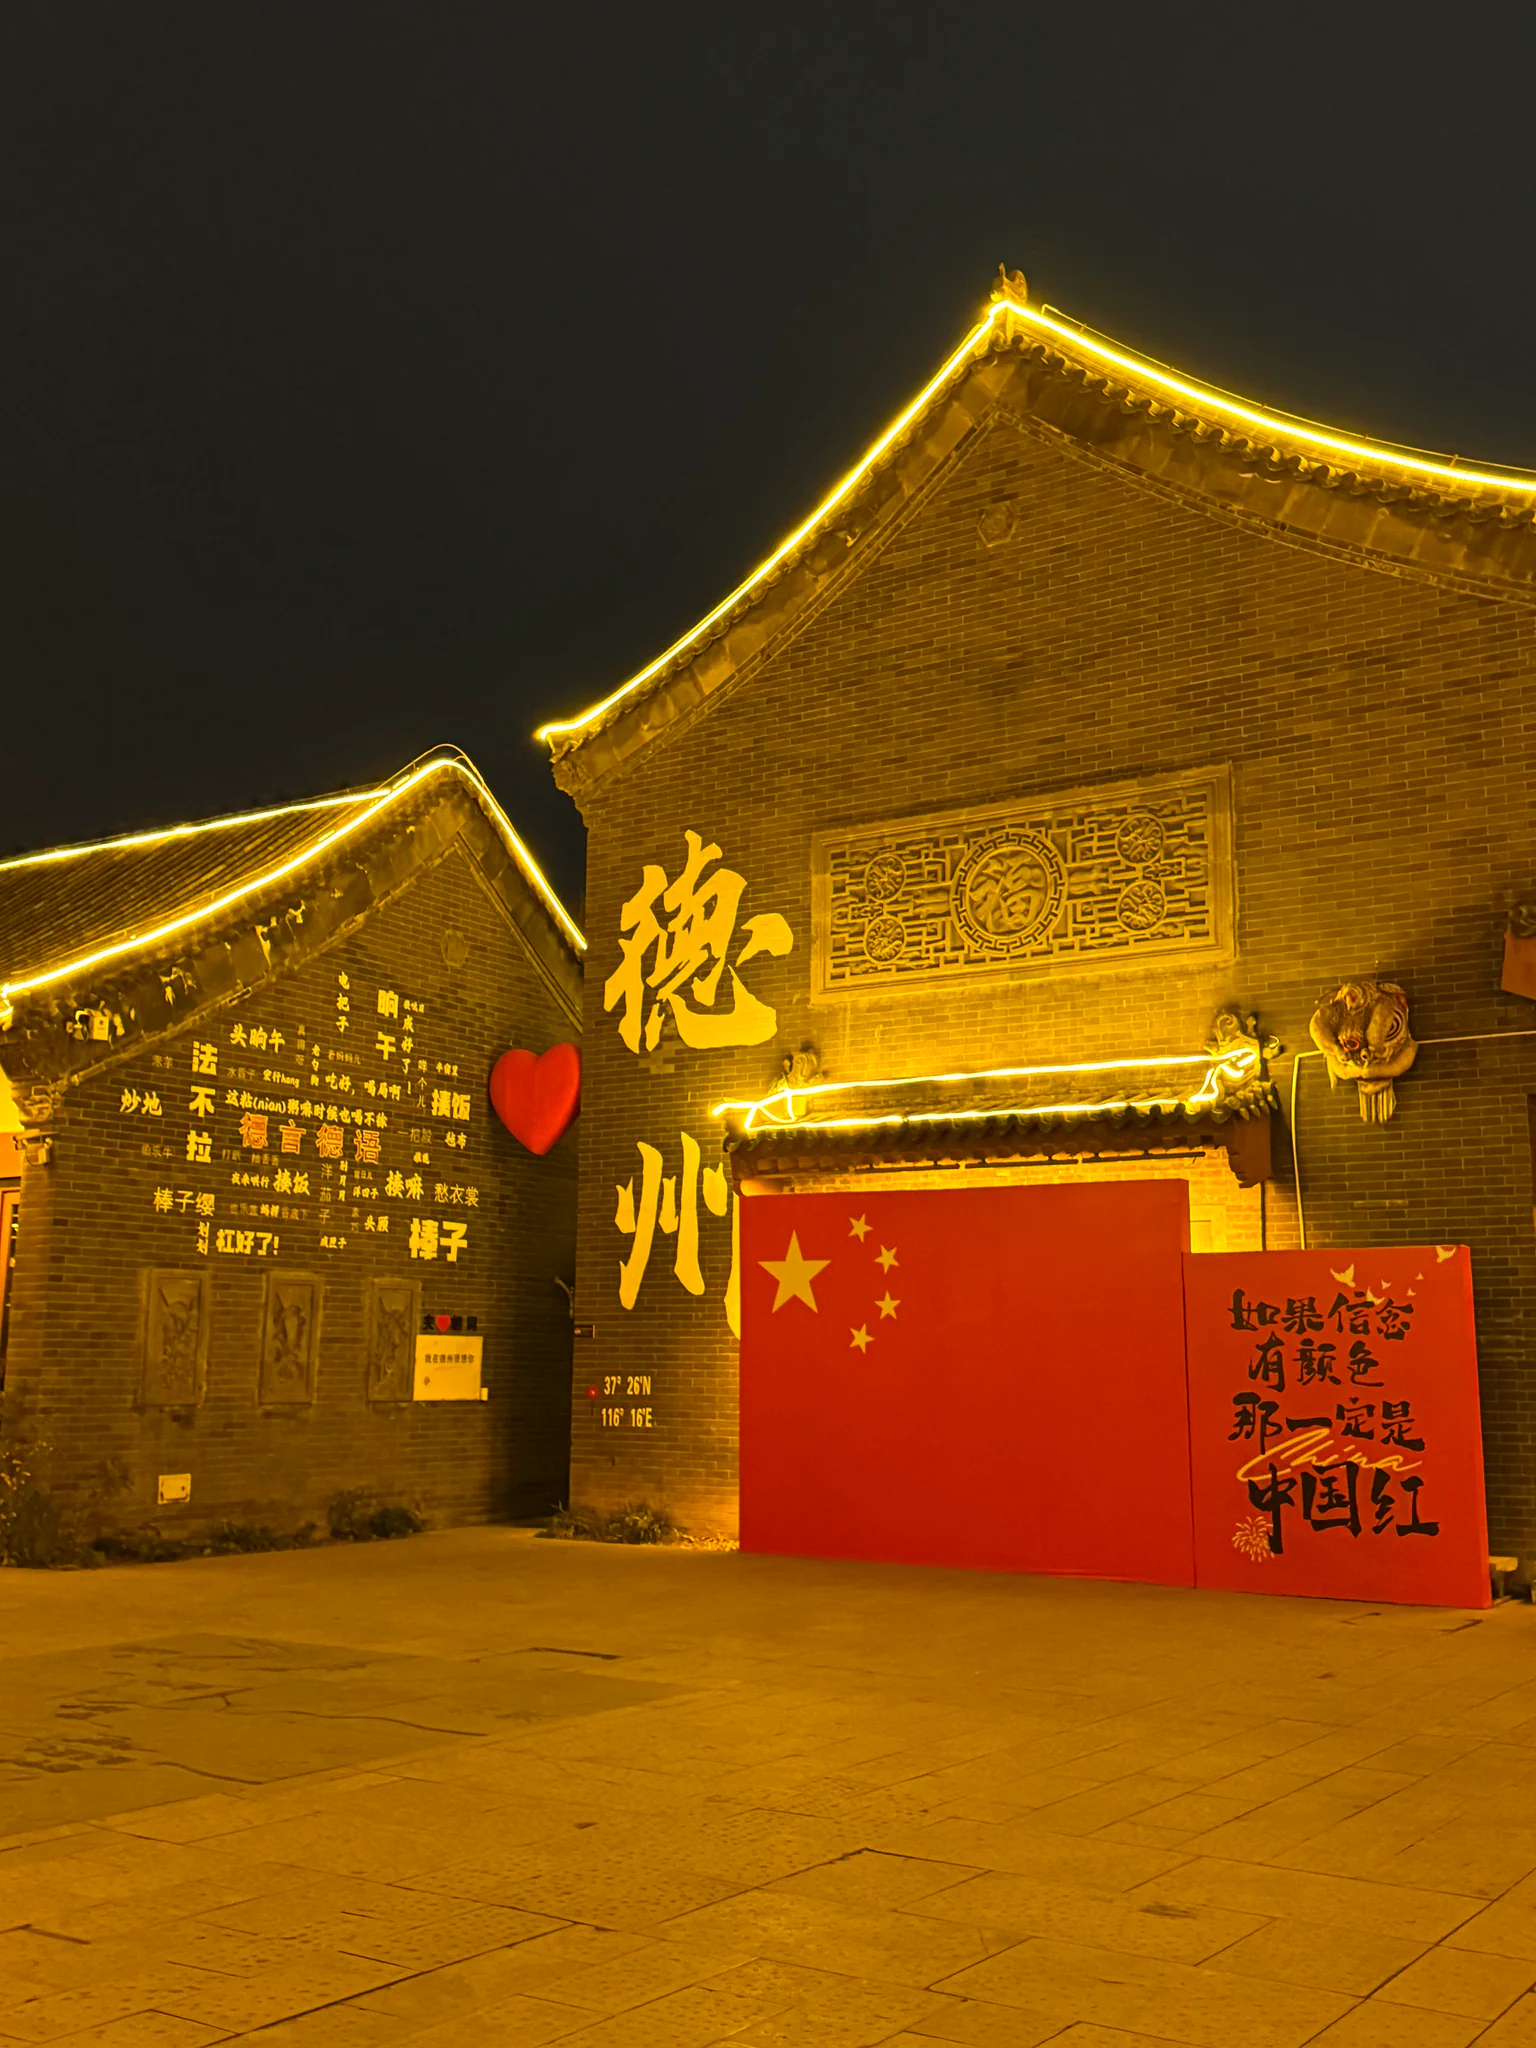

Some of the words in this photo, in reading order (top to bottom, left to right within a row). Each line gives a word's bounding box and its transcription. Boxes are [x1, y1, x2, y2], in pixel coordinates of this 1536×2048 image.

[229, 1023, 286, 1054] 头晌午
[119, 1088, 163, 1116] 炒地
[186, 1040, 218, 1163] 法不拉
[603, 829, 794, 1341] 德州
[238, 1111, 382, 1165] 德言德语
[153, 1186, 215, 1216] 棒子缨
[408, 1217, 468, 1262] 棒子
[1227, 1289, 1414, 1341] 如果信念
[1249, 1332, 1385, 1392] 有颜色
[1227, 1392, 1426, 1455] 那一定是
[1236, 1427, 1424, 1482] China
[1249, 1461, 1440, 1554] 中国红
